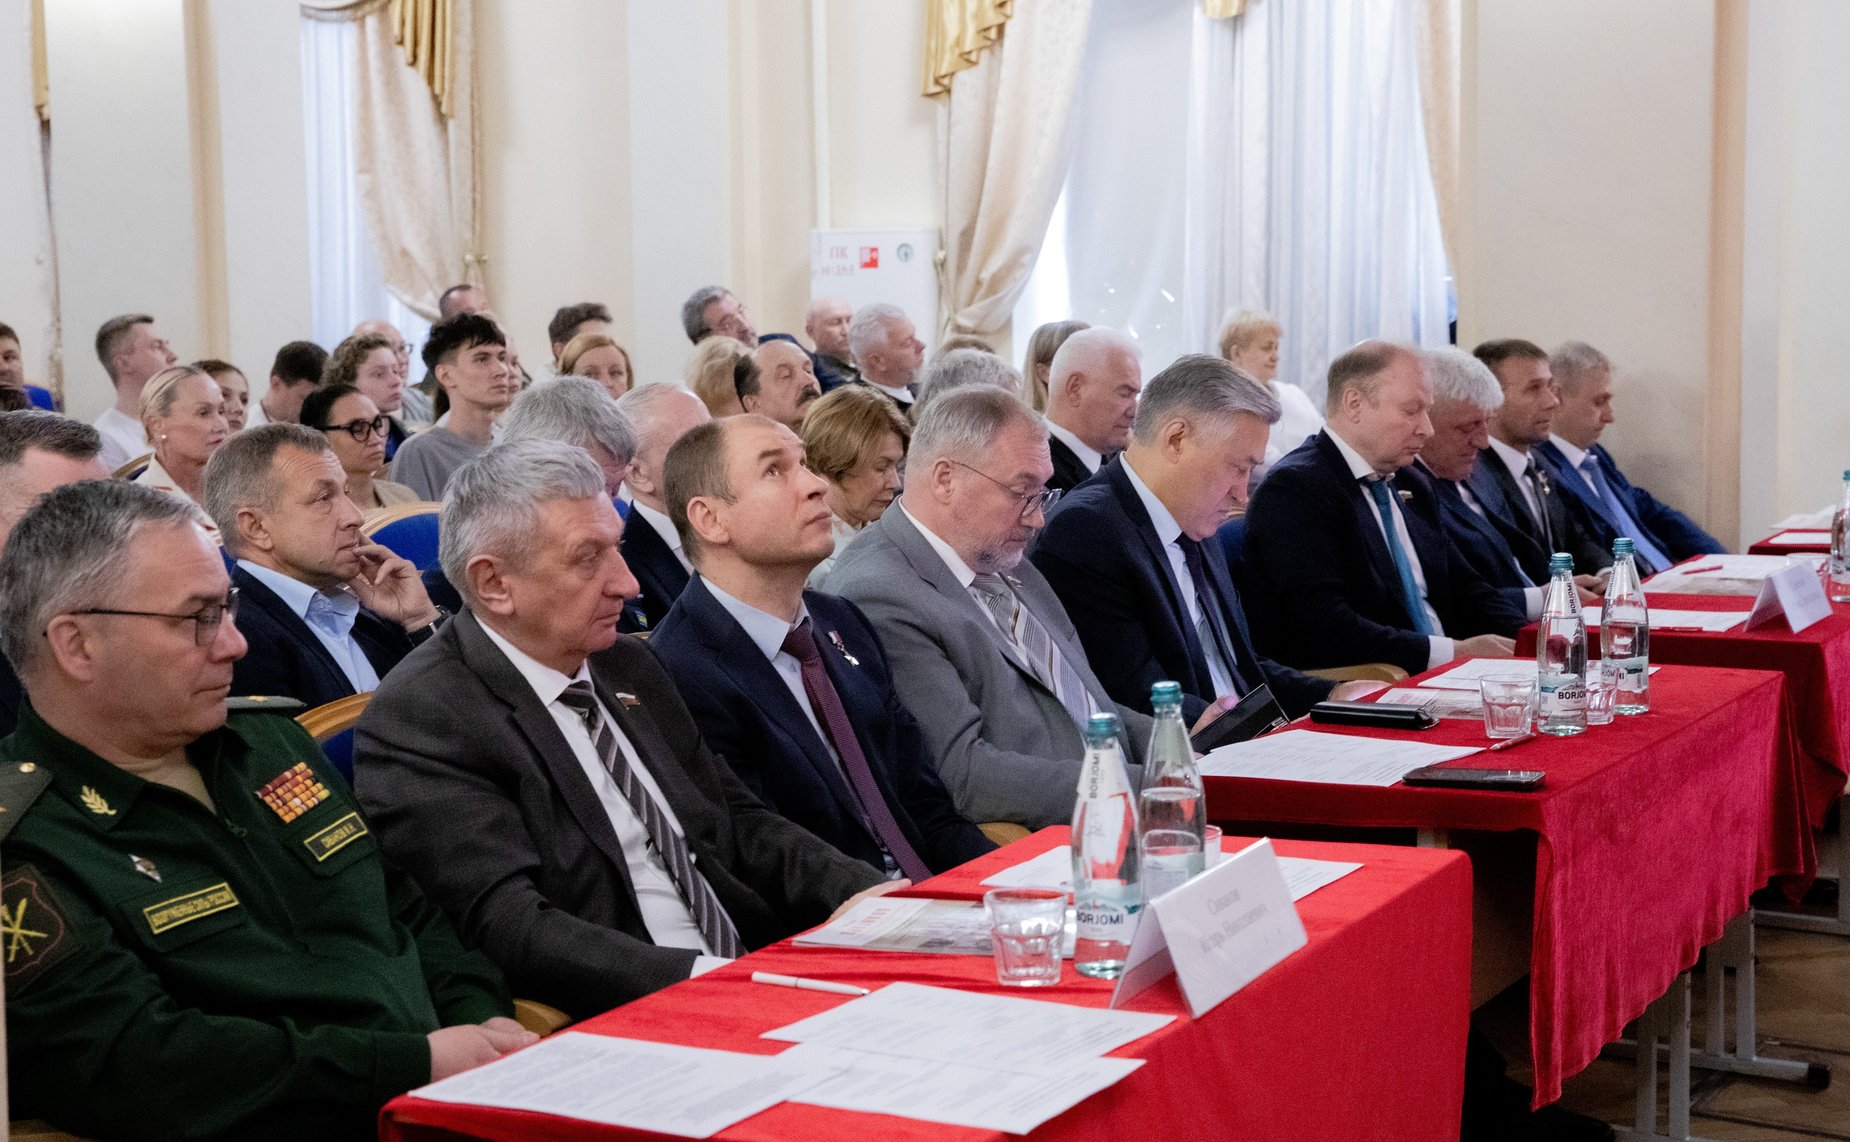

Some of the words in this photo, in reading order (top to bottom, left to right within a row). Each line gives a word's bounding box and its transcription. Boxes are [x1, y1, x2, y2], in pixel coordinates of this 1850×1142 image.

[1566, 582, 1577, 614] BORJOMI
[1090, 753, 1100, 799] BORJOMI
[1077, 911, 1124, 925] BORJOMI
